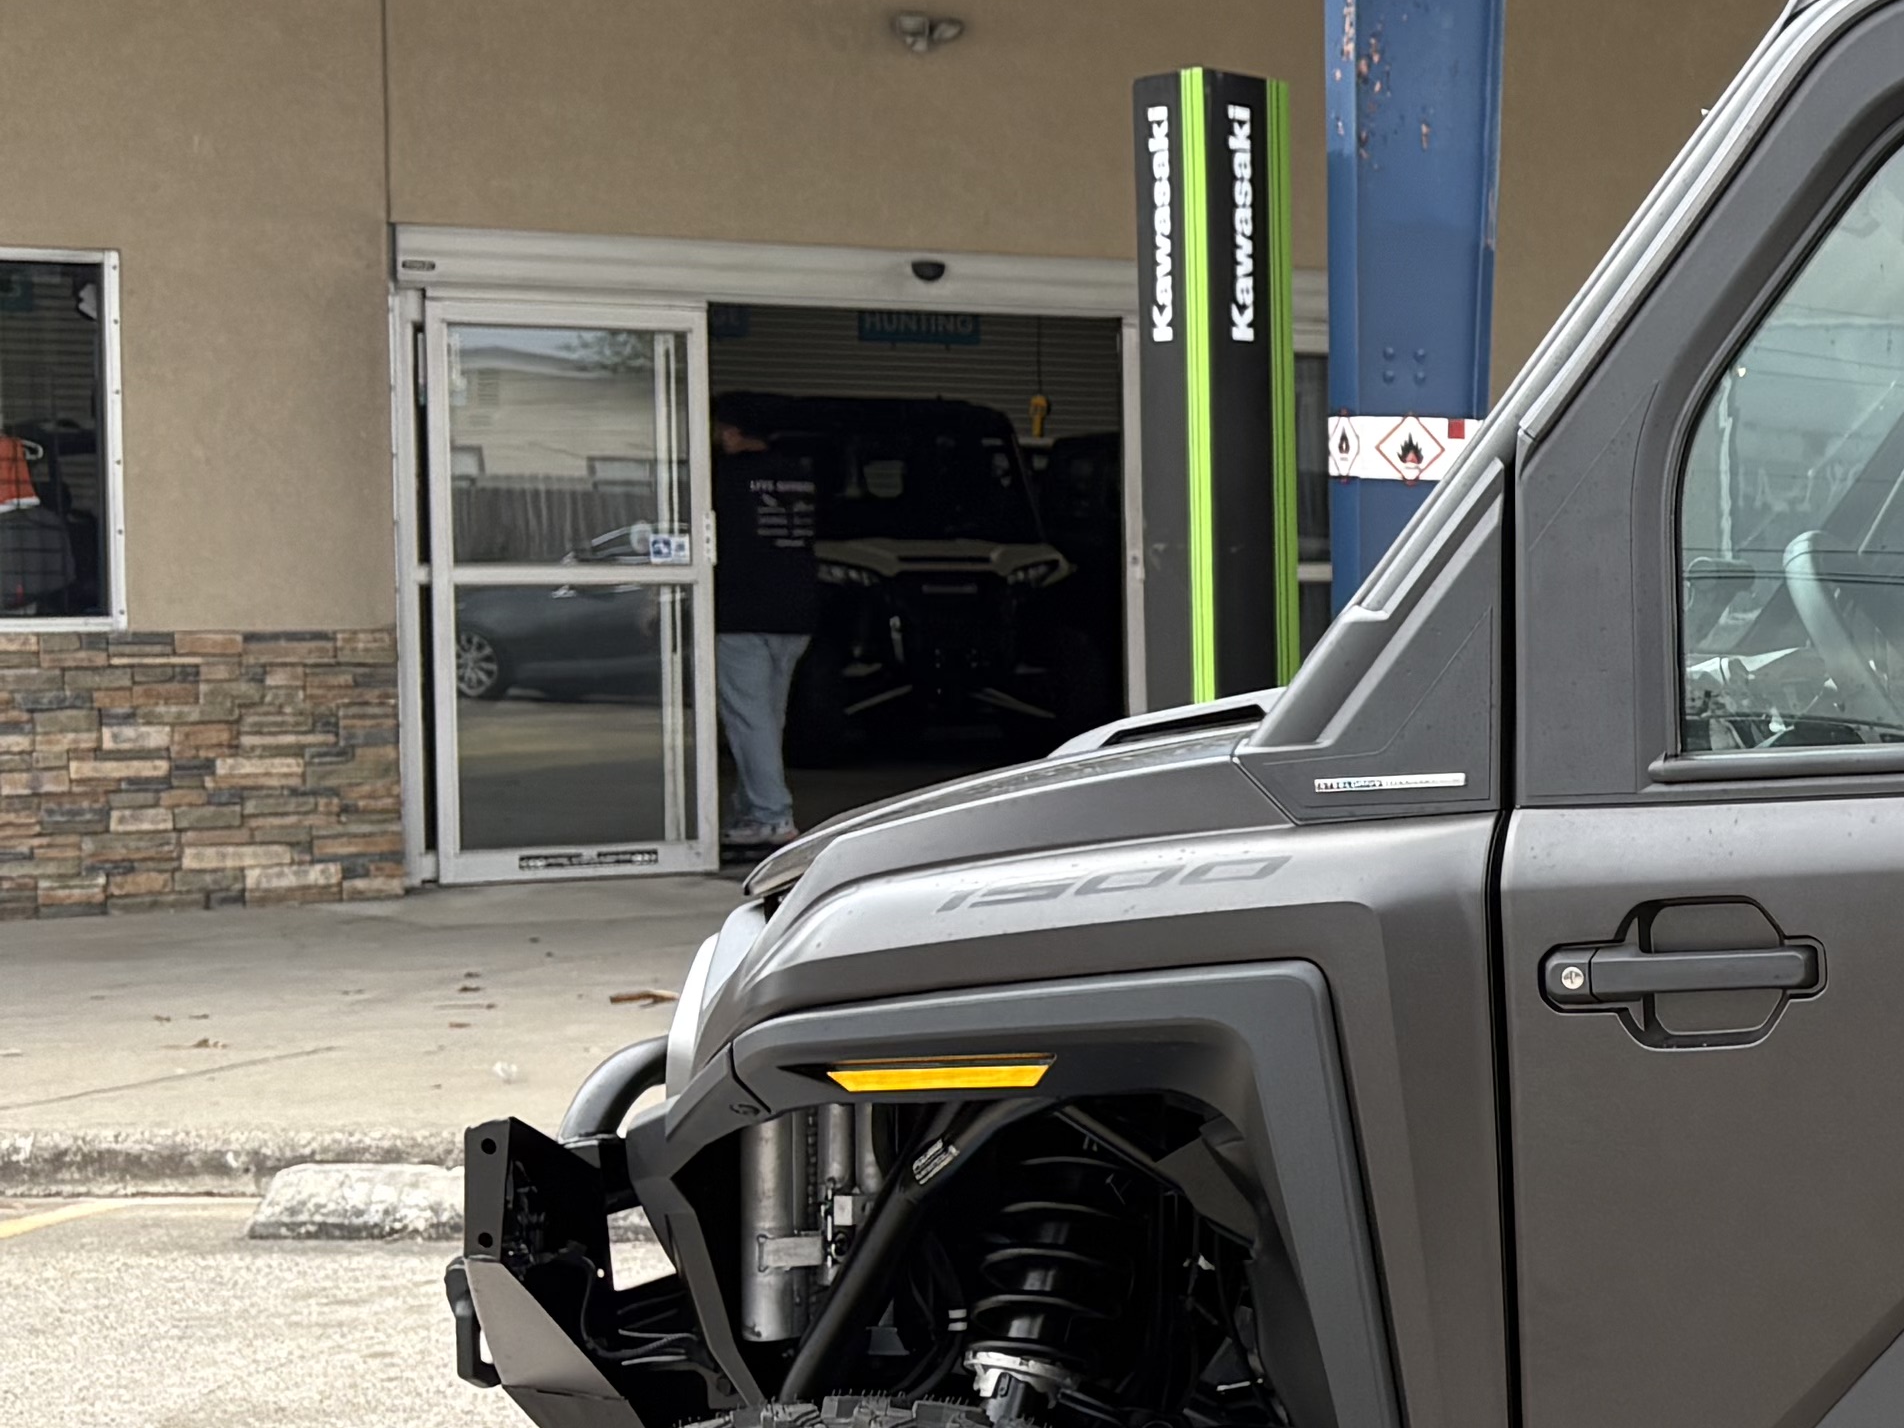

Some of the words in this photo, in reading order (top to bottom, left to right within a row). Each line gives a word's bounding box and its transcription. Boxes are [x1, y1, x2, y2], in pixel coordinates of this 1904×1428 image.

[1147, 105, 1173, 342] Kawasaki
[1227, 104, 1254, 342] Kawasaki
[864, 311, 973, 334] HUNTING
[934, 855, 1293, 914] 1500
